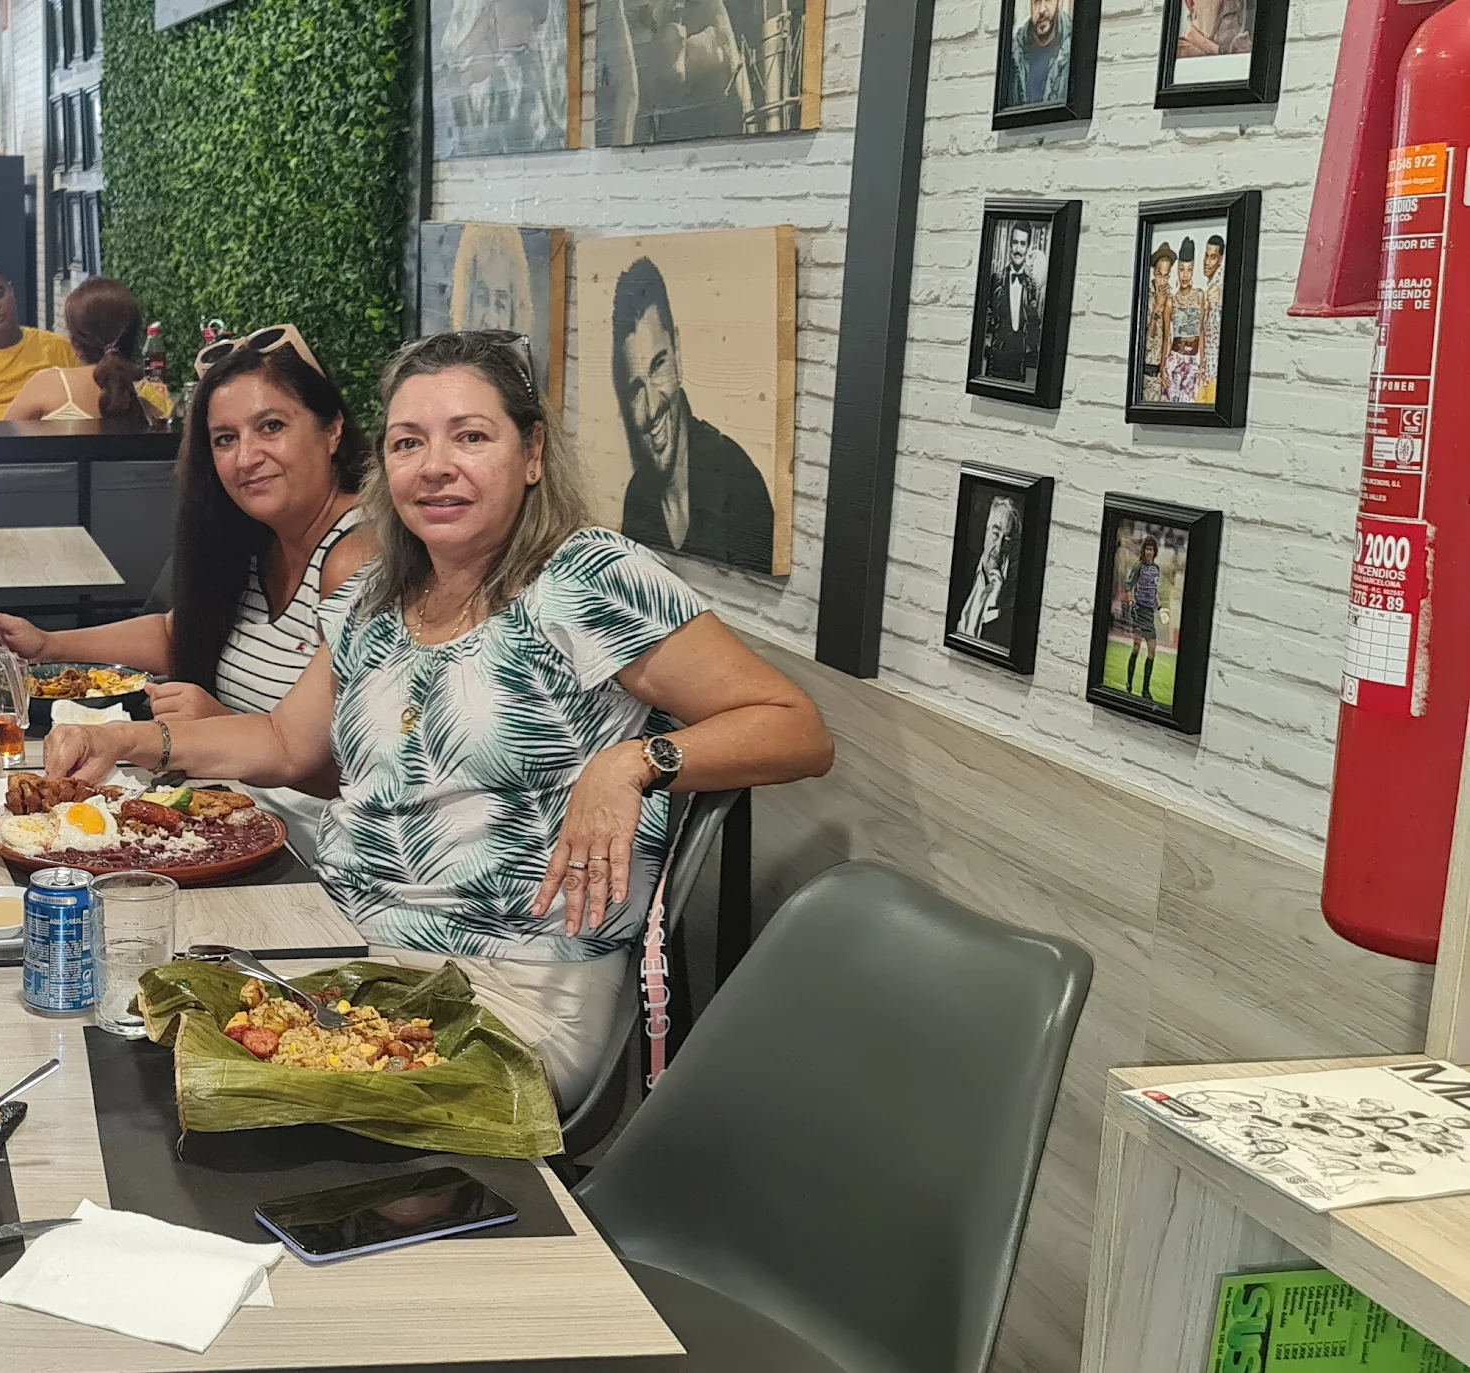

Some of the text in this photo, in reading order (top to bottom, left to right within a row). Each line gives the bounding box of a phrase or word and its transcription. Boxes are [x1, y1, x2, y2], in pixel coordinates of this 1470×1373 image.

[1414, 155, 1437, 169] 972
[1419, 238, 1436, 249] DE
[1398, 278, 1432, 288] ABAJO
[1414, 300, 1431, 310] DE
[1402, 410, 1422, 426] CE
[1364, 532, 1410, 571] 2000
[1362, 576, 1402, 589] BARCELONA
[1368, 592, 1383, 609] 22
[1386, 595, 1404, 612] 89
[640, 903, 671, 1039] GUESS
